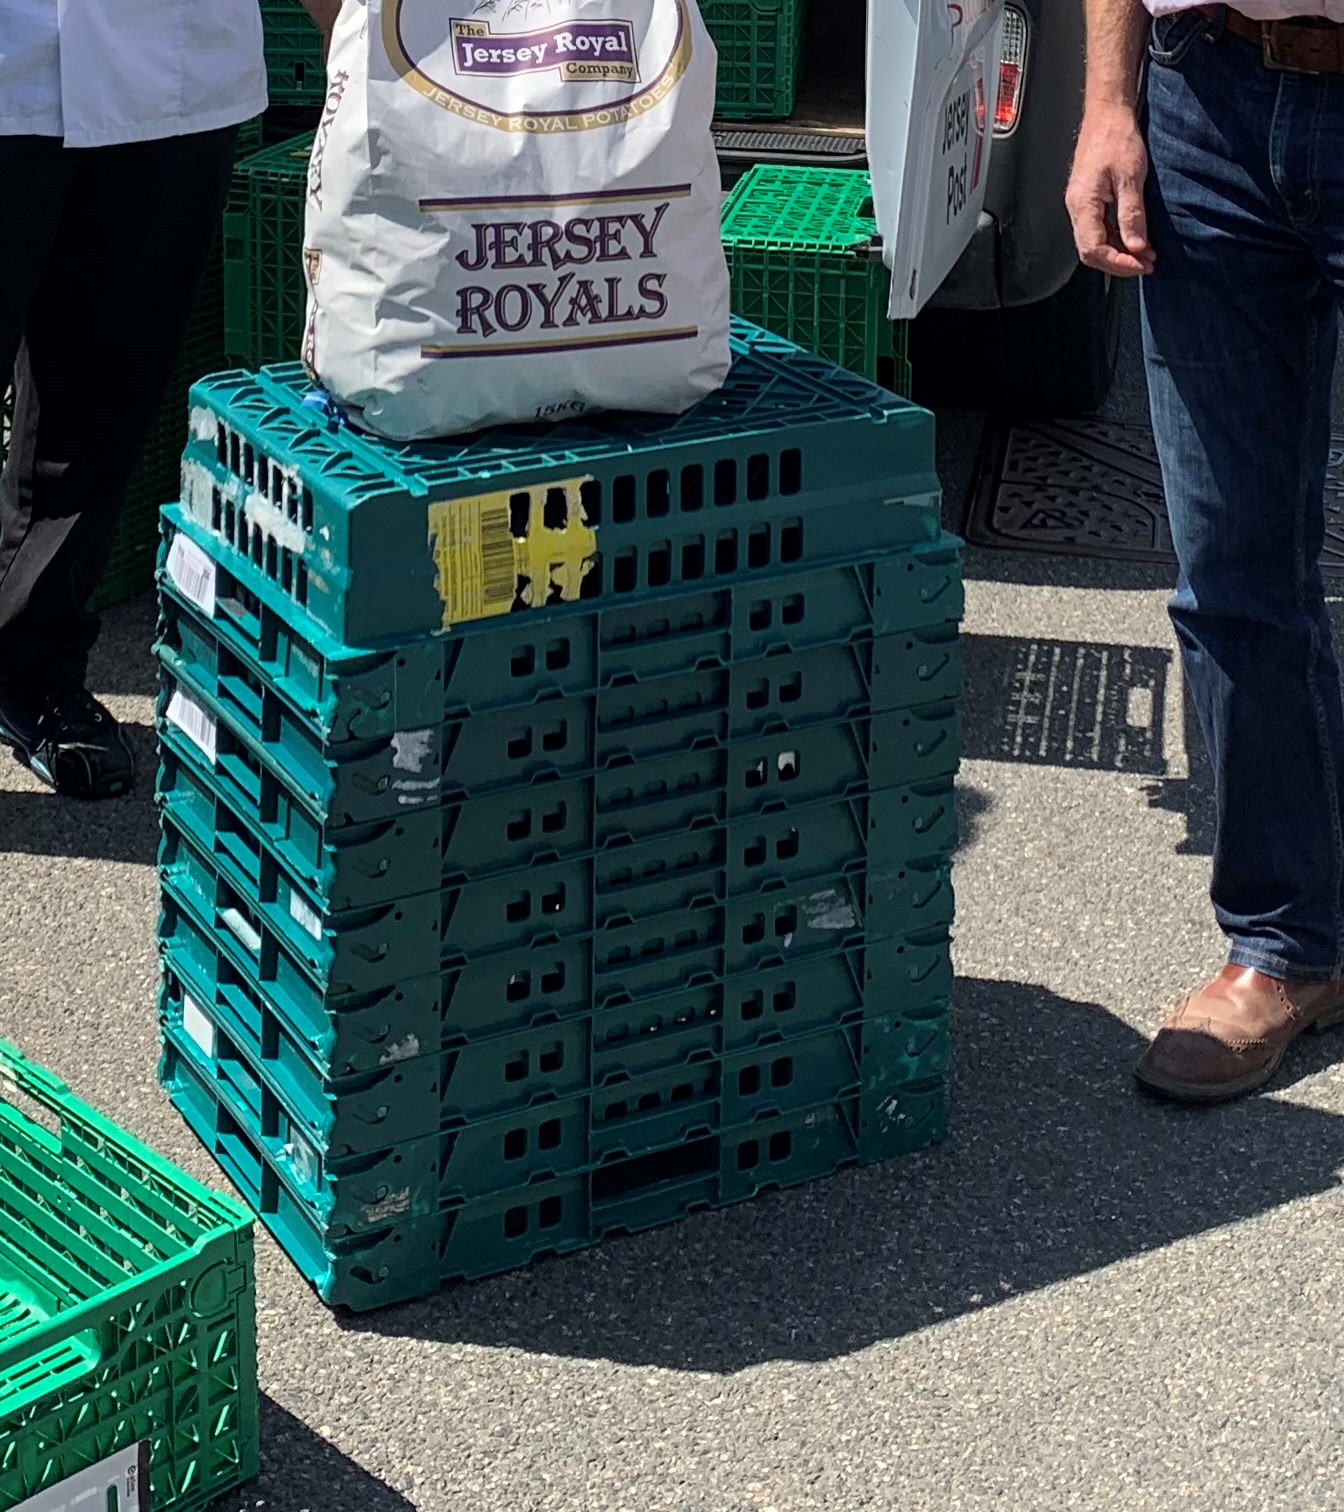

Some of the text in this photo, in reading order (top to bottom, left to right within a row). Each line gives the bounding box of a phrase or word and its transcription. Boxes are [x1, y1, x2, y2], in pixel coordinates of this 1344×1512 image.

[456, 24, 485, 37] The
[462, 31, 628, 68] Jersey Royal
[566, 62, 634, 79] Company
[422, 74, 675, 132] JERSEY ROYAL POTATOES
[943, 89, 971, 155] Jersey
[947, 152, 967, 225] Post
[455, 202, 670, 271] JERSEY
[456, 272, 668, 338] ROYALS
